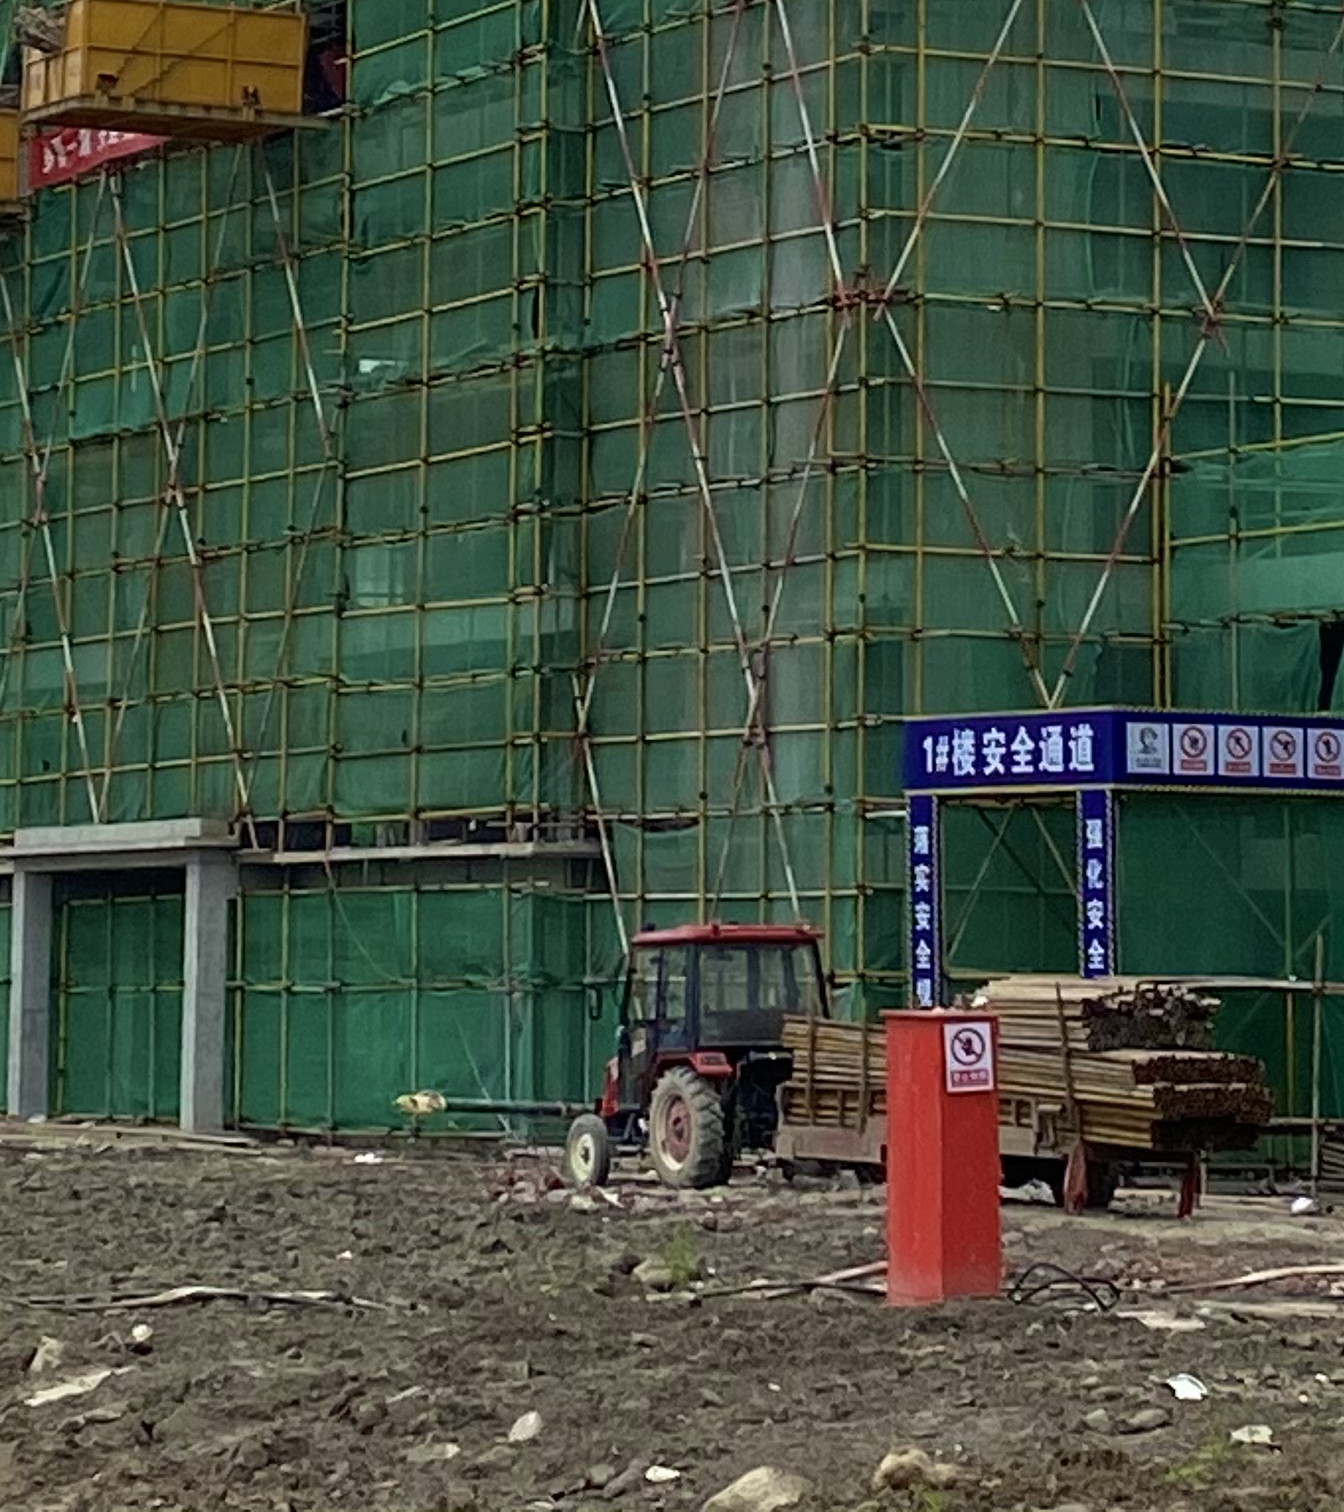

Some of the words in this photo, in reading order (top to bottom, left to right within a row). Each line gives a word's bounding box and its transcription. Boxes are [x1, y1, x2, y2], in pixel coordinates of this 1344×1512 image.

[922, 723, 1095, 776] 1#楼安全通道
